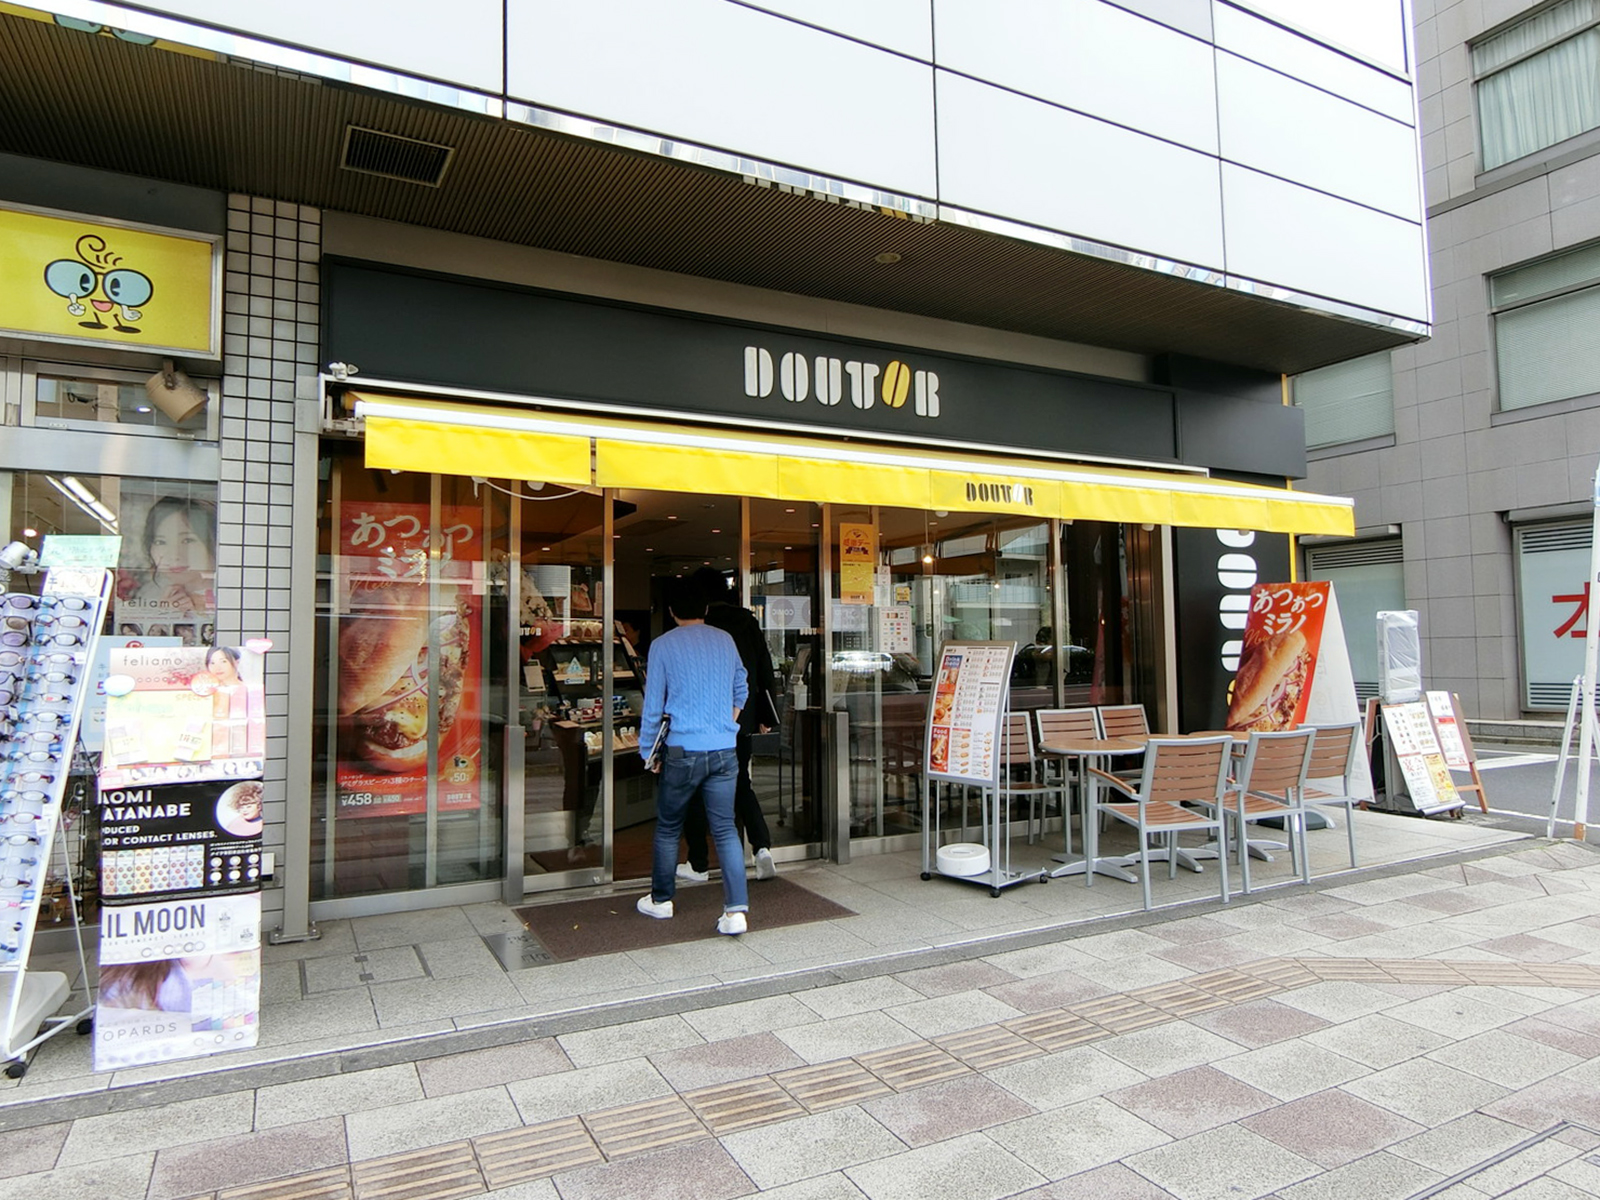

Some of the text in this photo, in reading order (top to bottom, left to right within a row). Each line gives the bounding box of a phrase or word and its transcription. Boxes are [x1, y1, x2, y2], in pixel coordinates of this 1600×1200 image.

[744, 346, 940, 417] DOUTOR
[966, 482, 1033, 505] DOUTOR
[1253, 588, 1323, 614] あつあつ
[1263, 613, 1307, 635] ミラノ
[123, 655, 183, 667] feliamo
[341, 793, 372, 806] ¥458
[122, 834, 172, 845] CONTACT
[176, 830, 217, 840] LENSES.
[134, 904, 205, 936] MOON
